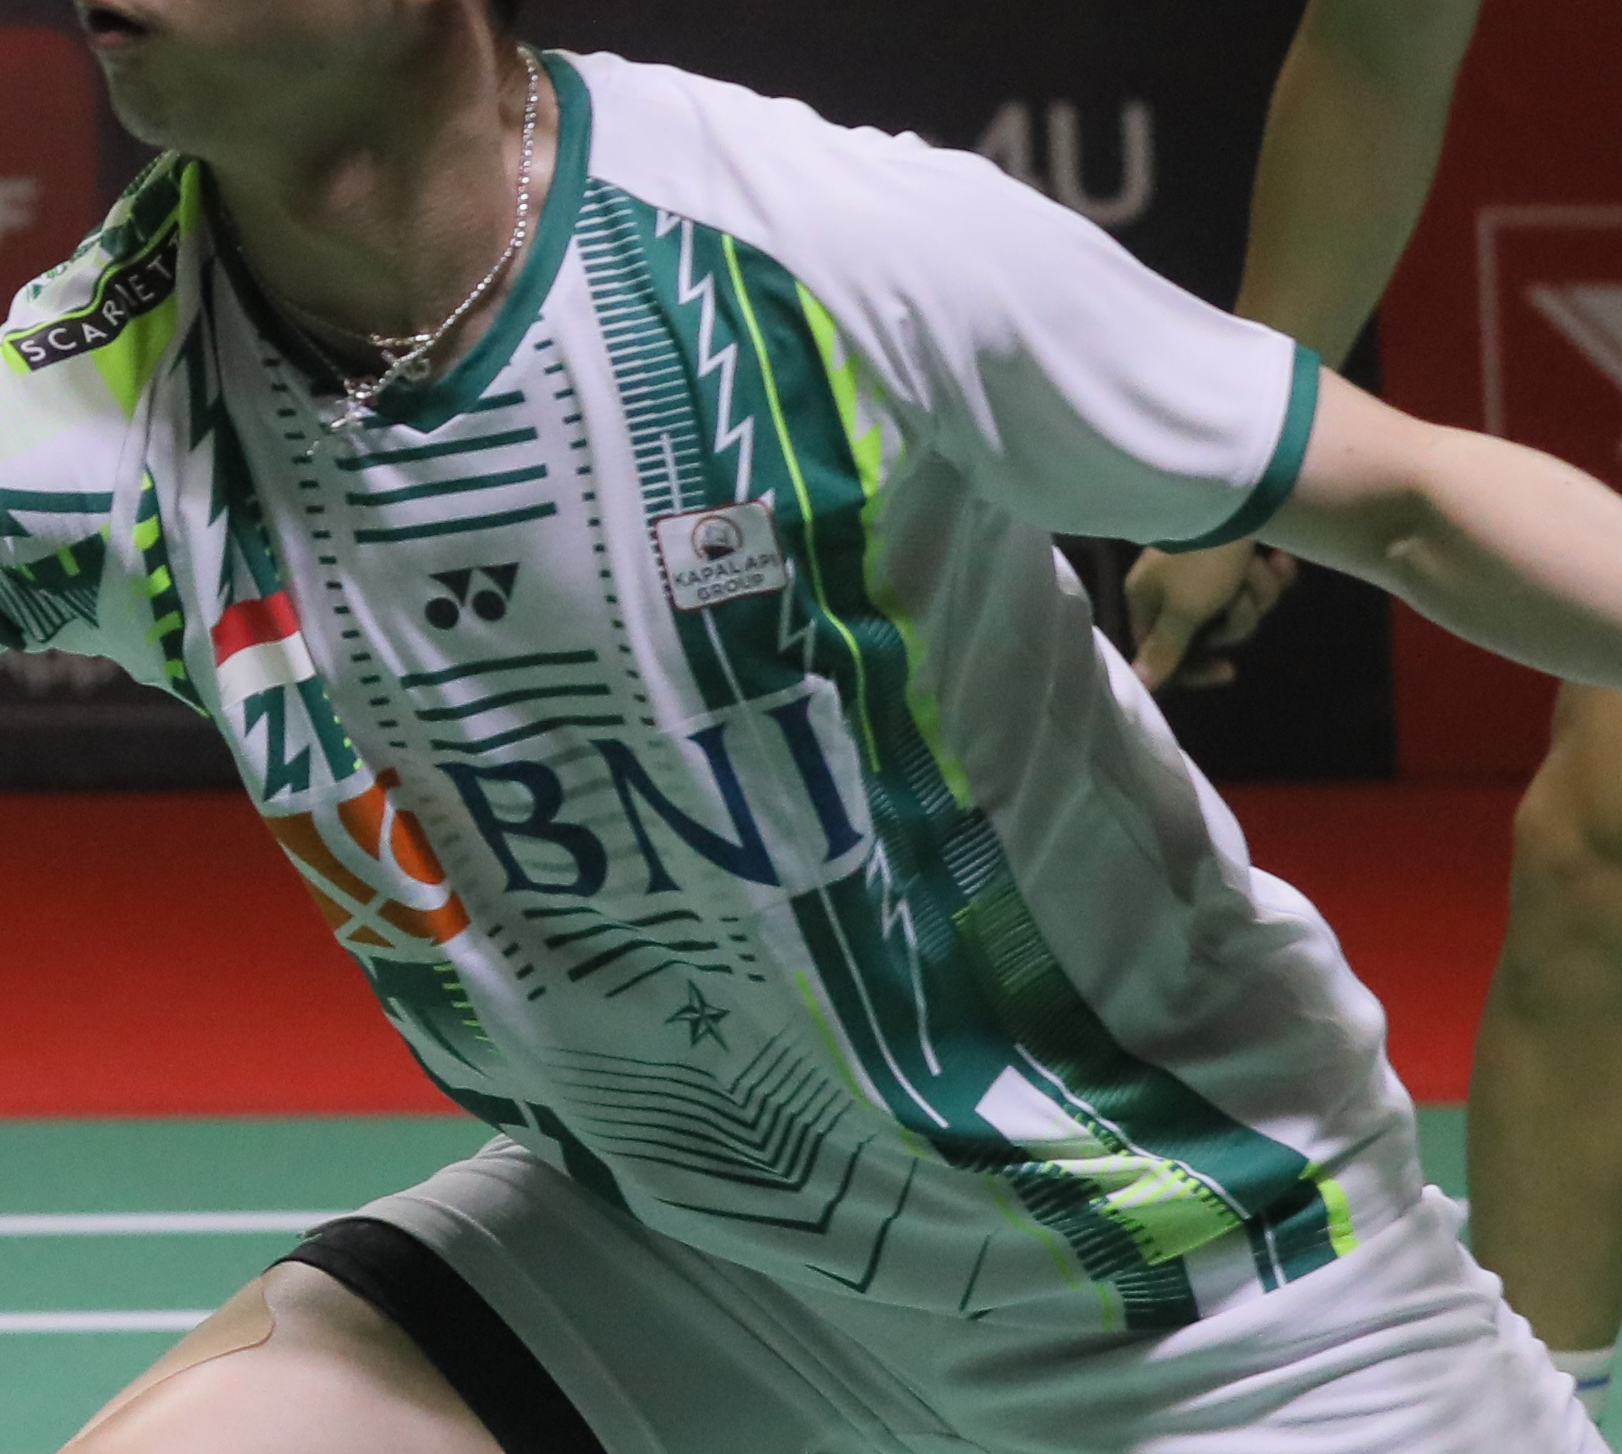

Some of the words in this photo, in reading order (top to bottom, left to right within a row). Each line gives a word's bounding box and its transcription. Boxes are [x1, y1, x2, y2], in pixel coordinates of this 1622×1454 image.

[673, 560, 742, 584] KAPAL
[696, 573, 764, 600] GROUP
[435, 693, 865, 898] BNI
